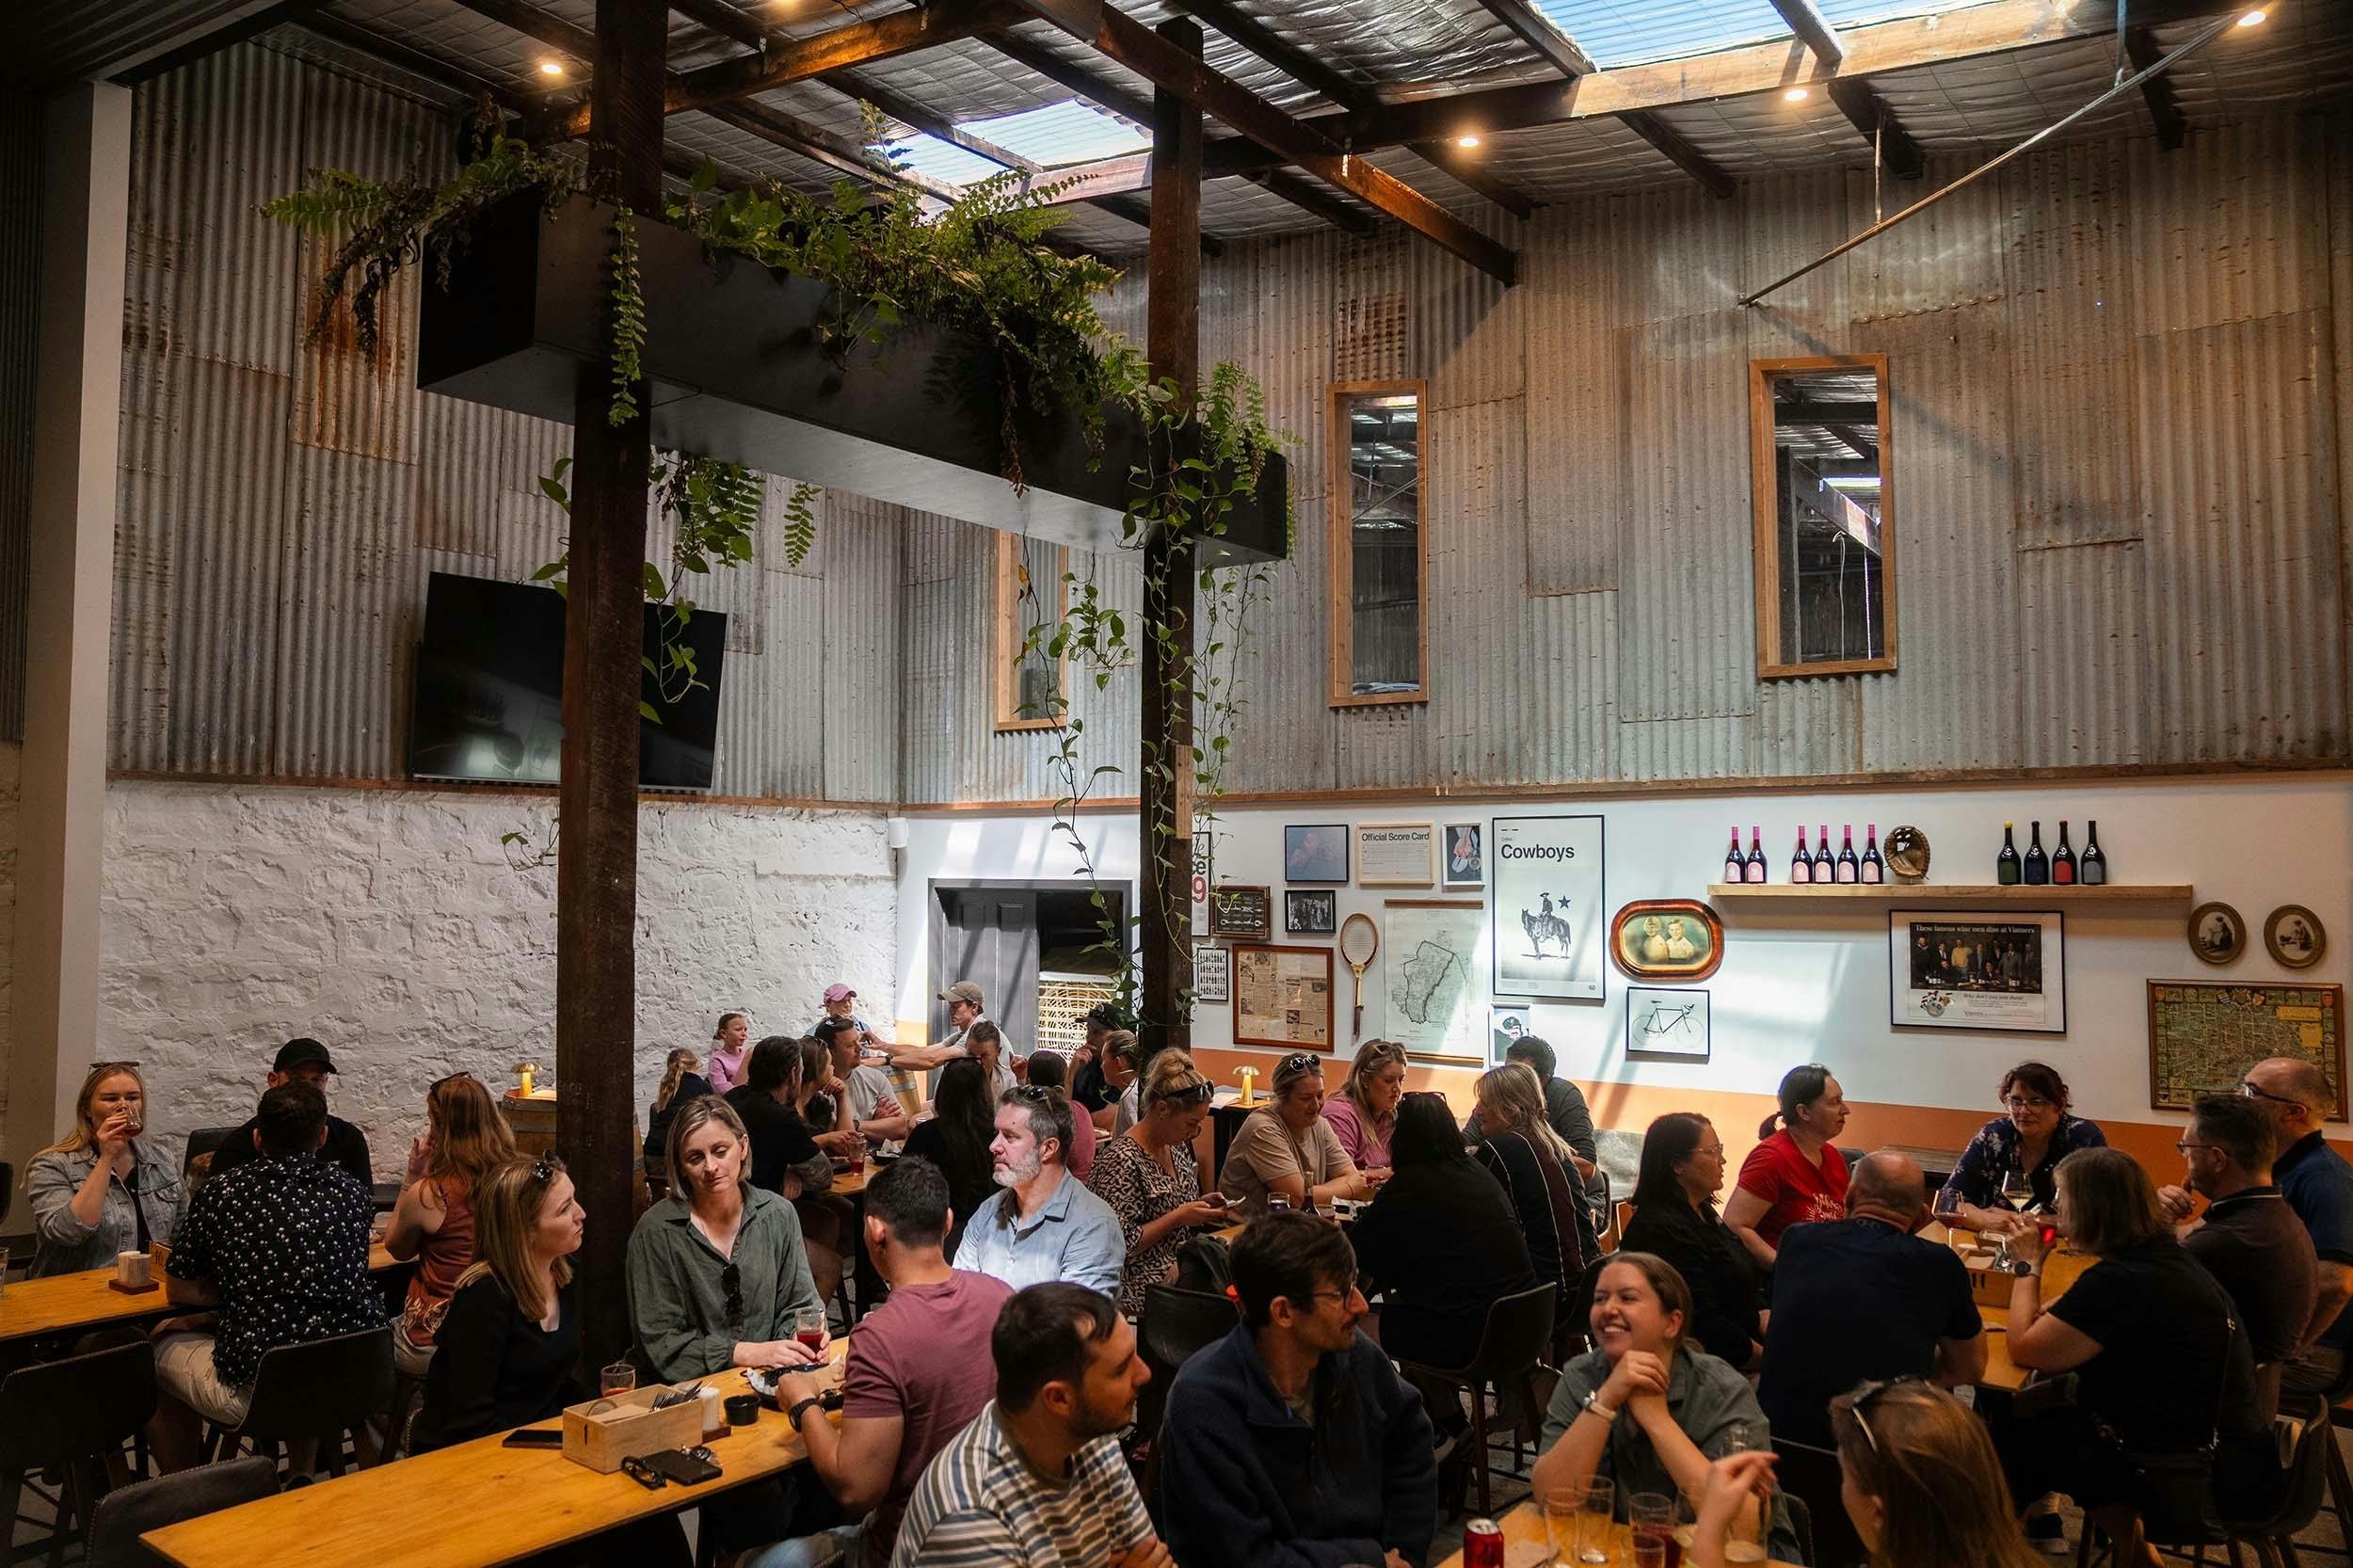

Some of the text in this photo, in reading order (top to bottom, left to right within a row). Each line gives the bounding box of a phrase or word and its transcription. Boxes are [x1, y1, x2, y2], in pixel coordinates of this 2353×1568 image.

[1361, 832, 1430, 841] Official Score Card
[1501, 843, 1575, 863] Cowboys
